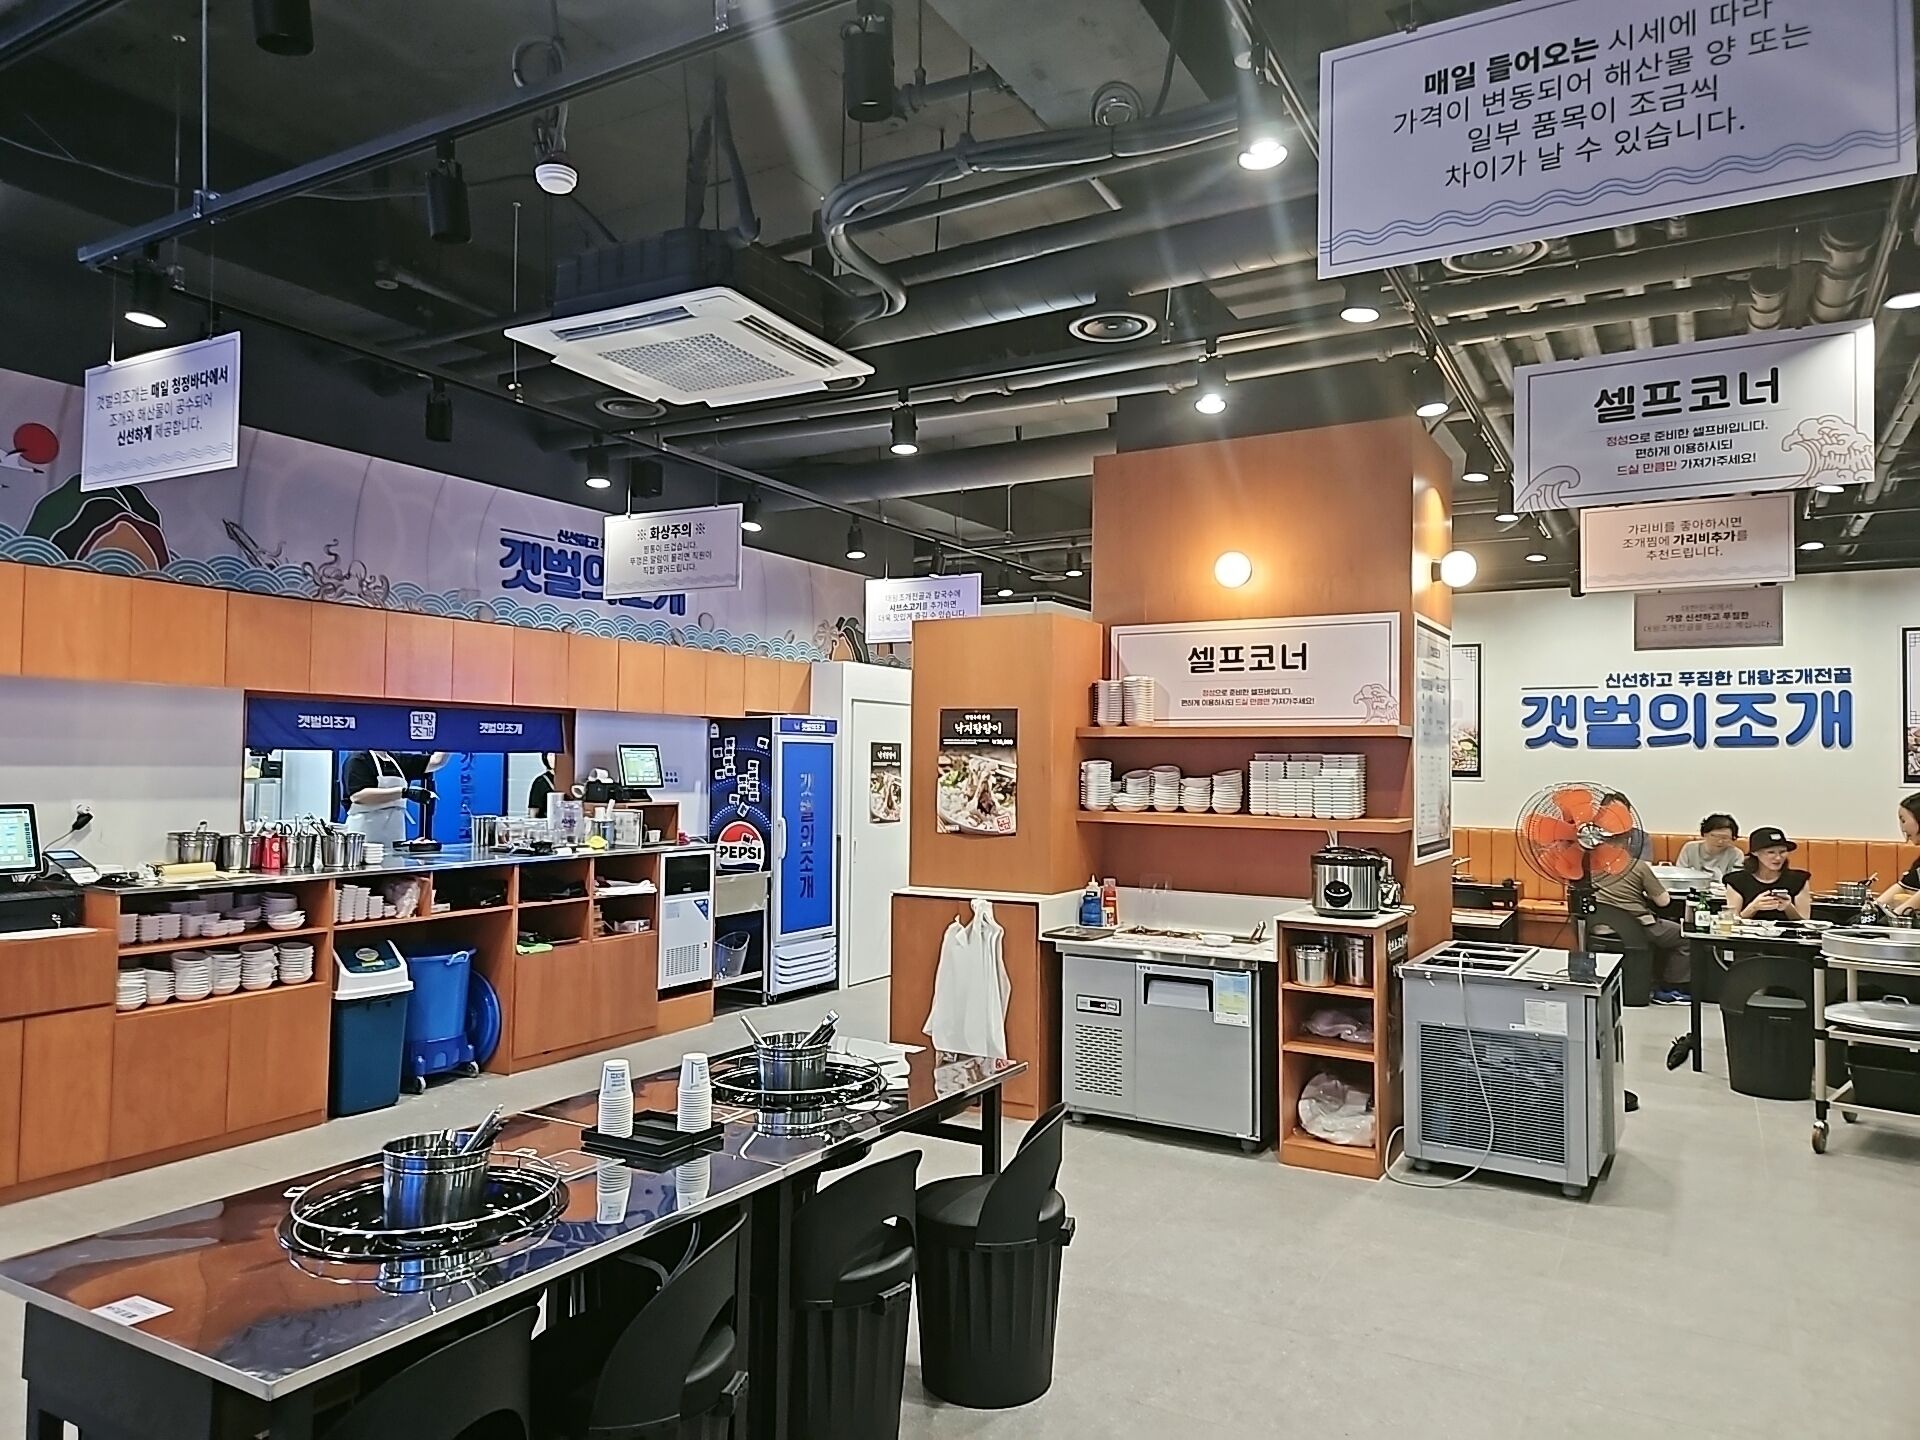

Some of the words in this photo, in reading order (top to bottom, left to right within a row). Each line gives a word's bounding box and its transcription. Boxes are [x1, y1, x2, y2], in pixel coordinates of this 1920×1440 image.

[1424, 61, 1476, 95] 매일
[1487, 37, 1599, 84] 들어오는
[1608, 9, 1696, 51] 시세에
[1710, 0, 1773, 27] 따라
[1393, 96, 1470, 135] 가격이
[1482, 67, 1592, 117] 변동되어
[1604, 46, 1693, 86] 해산물
[1706, 35, 1736, 66] 양
[1748, 23, 1812, 56] 또는
[1468, 121, 1520, 153] 일부
[1532, 96, 1616, 139] 품목이
[1629, 74, 1718, 117] 조금씩
[1445, 151, 1527, 188] 차이가
[1538, 142, 1565, 171] 날
[1575, 136, 1602, 163] 수
[1615, 107, 1746, 156] 있습니다.
[151, 380, 169, 398] 매일
[171, 365, 228, 394] 청정바다에서
[175, 392, 213, 415] 공수되어
[1594, 367, 1779, 423] 셀프코너
[117, 425, 152, 446] 신선하게
[1606, 432, 1651, 447] 정성으로
[1654, 428, 1689, 442] 준비한
[1693, 419, 1769, 438] 셀프바입니다.
[1635, 445, 1670, 459] 편하게
[1674, 439, 1733, 455] 이용하시되
[1617, 463, 1640, 476] 드실
[1643, 461, 1677, 474] 만큼만
[1681, 452, 1757, 470] 가져가주세요!
[649, 522, 692, 540] 화상주의
[1628, 521, 1675, 535] 가리비를
[1680, 516, 1742, 532] 좋아하시면
[1673, 529, 1748, 545] 가리비추가를
[1646, 546, 1724, 560] 추천드립니다.
[1188, 643, 1306, 673] 셀프코너
[1605, 670, 1672, 688] 신선하고
[1679, 669, 1733, 686] 푸짐한
[1738, 667, 1853, 685] 대왕조개전골
[298, 715, 356, 729] 갯벌의조개
[411, 712, 434, 726] 대왕
[480, 722, 523, 734] 갯벌의조개
[1521, 689, 1854, 750] 갯벌의조개
[411, 725, 434, 738] 조개
[720, 845, 762, 860] PEPSI
